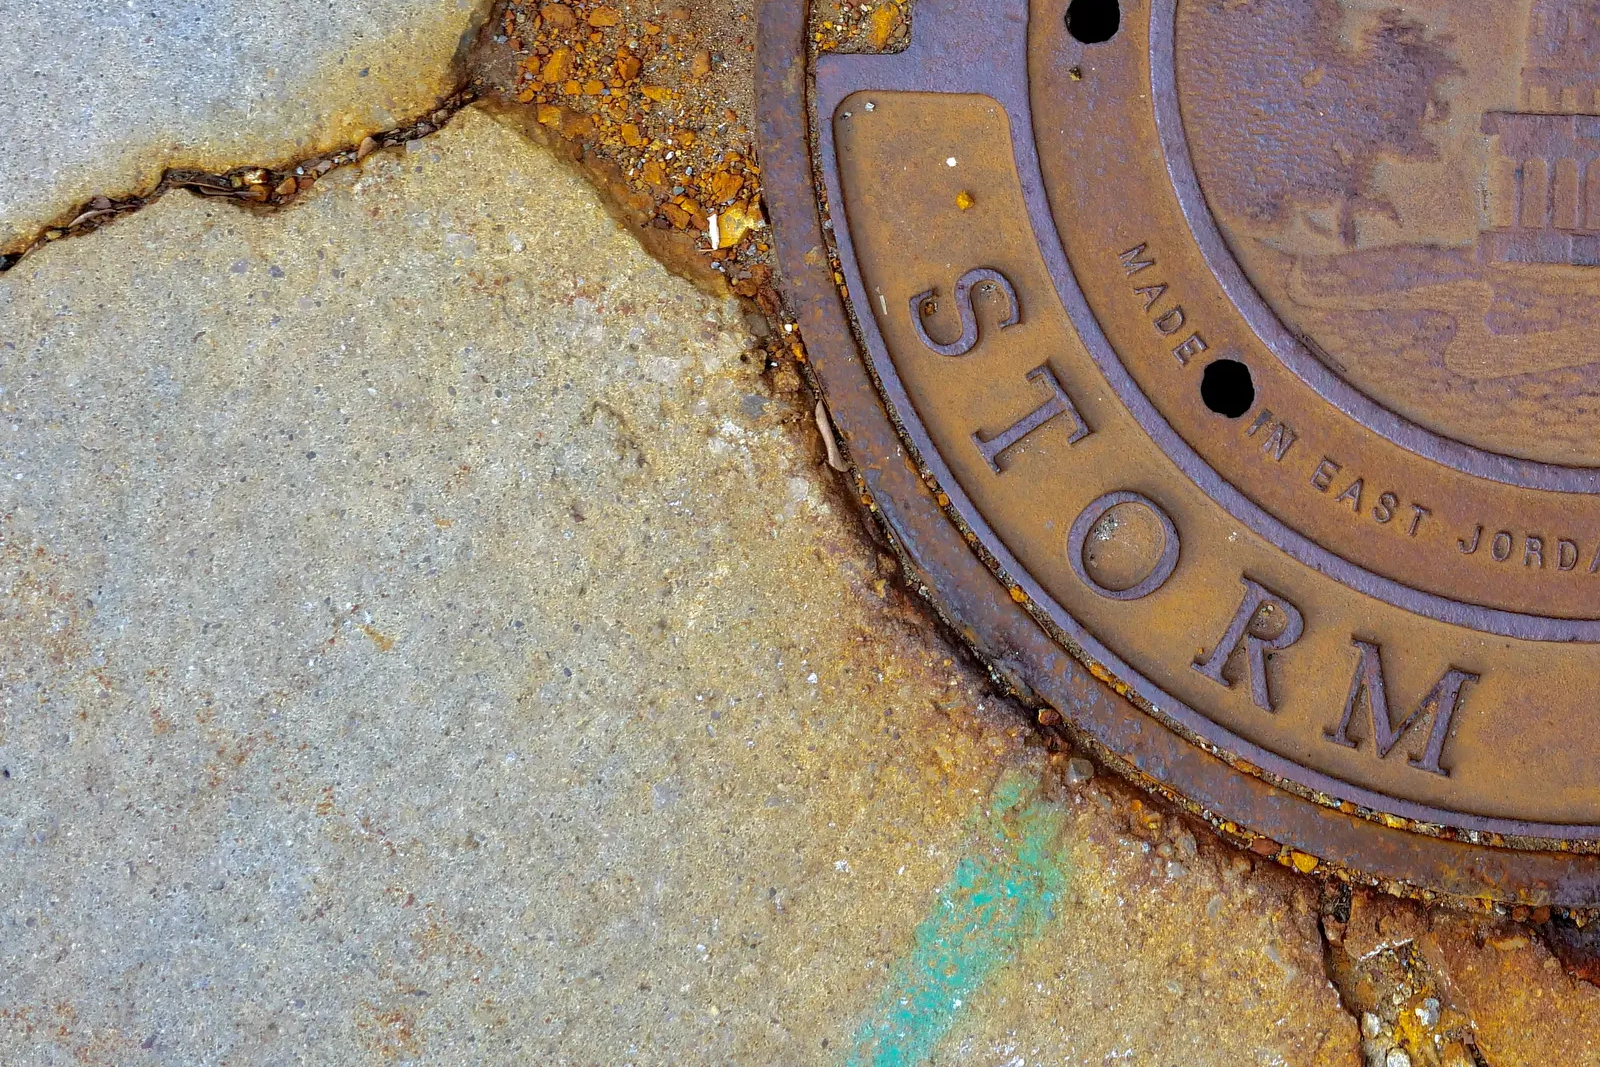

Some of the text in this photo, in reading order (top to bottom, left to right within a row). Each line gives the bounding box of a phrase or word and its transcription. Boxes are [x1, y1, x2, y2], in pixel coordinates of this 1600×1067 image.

[909, 267, 1480, 778] STORM
[1119, 242, 1209, 367] MADE
[1248, 409, 1301, 464] IN
[1310, 456, 1432, 537] EAST
